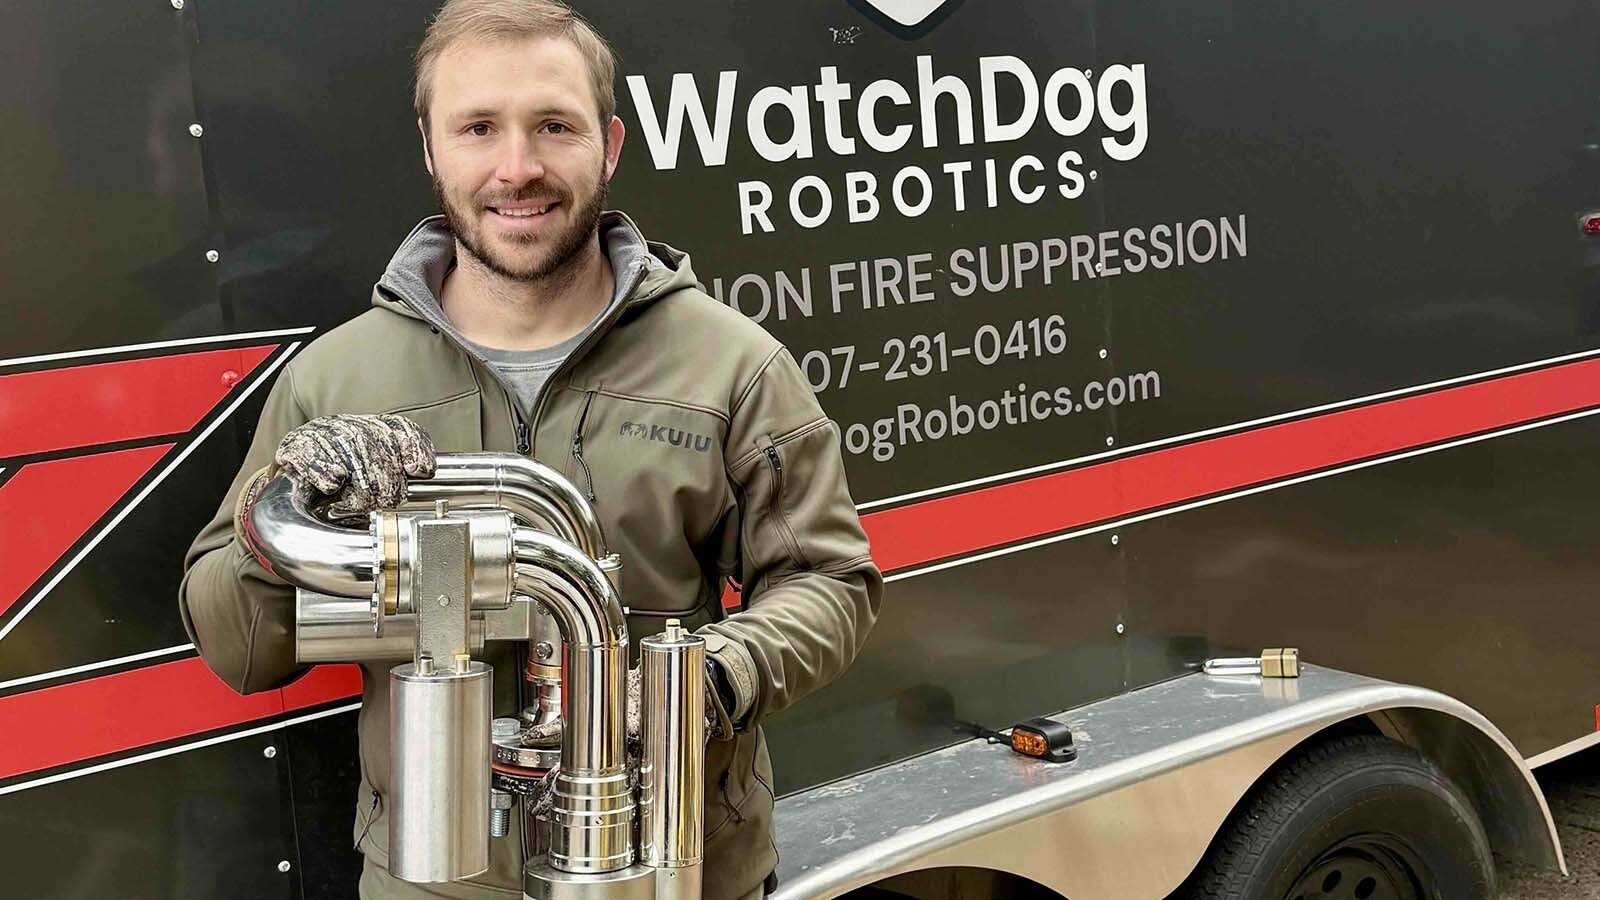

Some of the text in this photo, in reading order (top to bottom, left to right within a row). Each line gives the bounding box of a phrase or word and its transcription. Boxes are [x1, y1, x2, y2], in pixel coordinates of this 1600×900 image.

[625, 54, 1149, 171] WatchDog
[737, 150, 1086, 235] ROBOTICS
[696, 213, 1248, 325] ION FIRE SUPPRESSION
[800, 314, 1068, 394] 07-231-0416
[649, 424, 713, 453] KUIU
[829, 370, 1161, 463] ogRobotics.com
